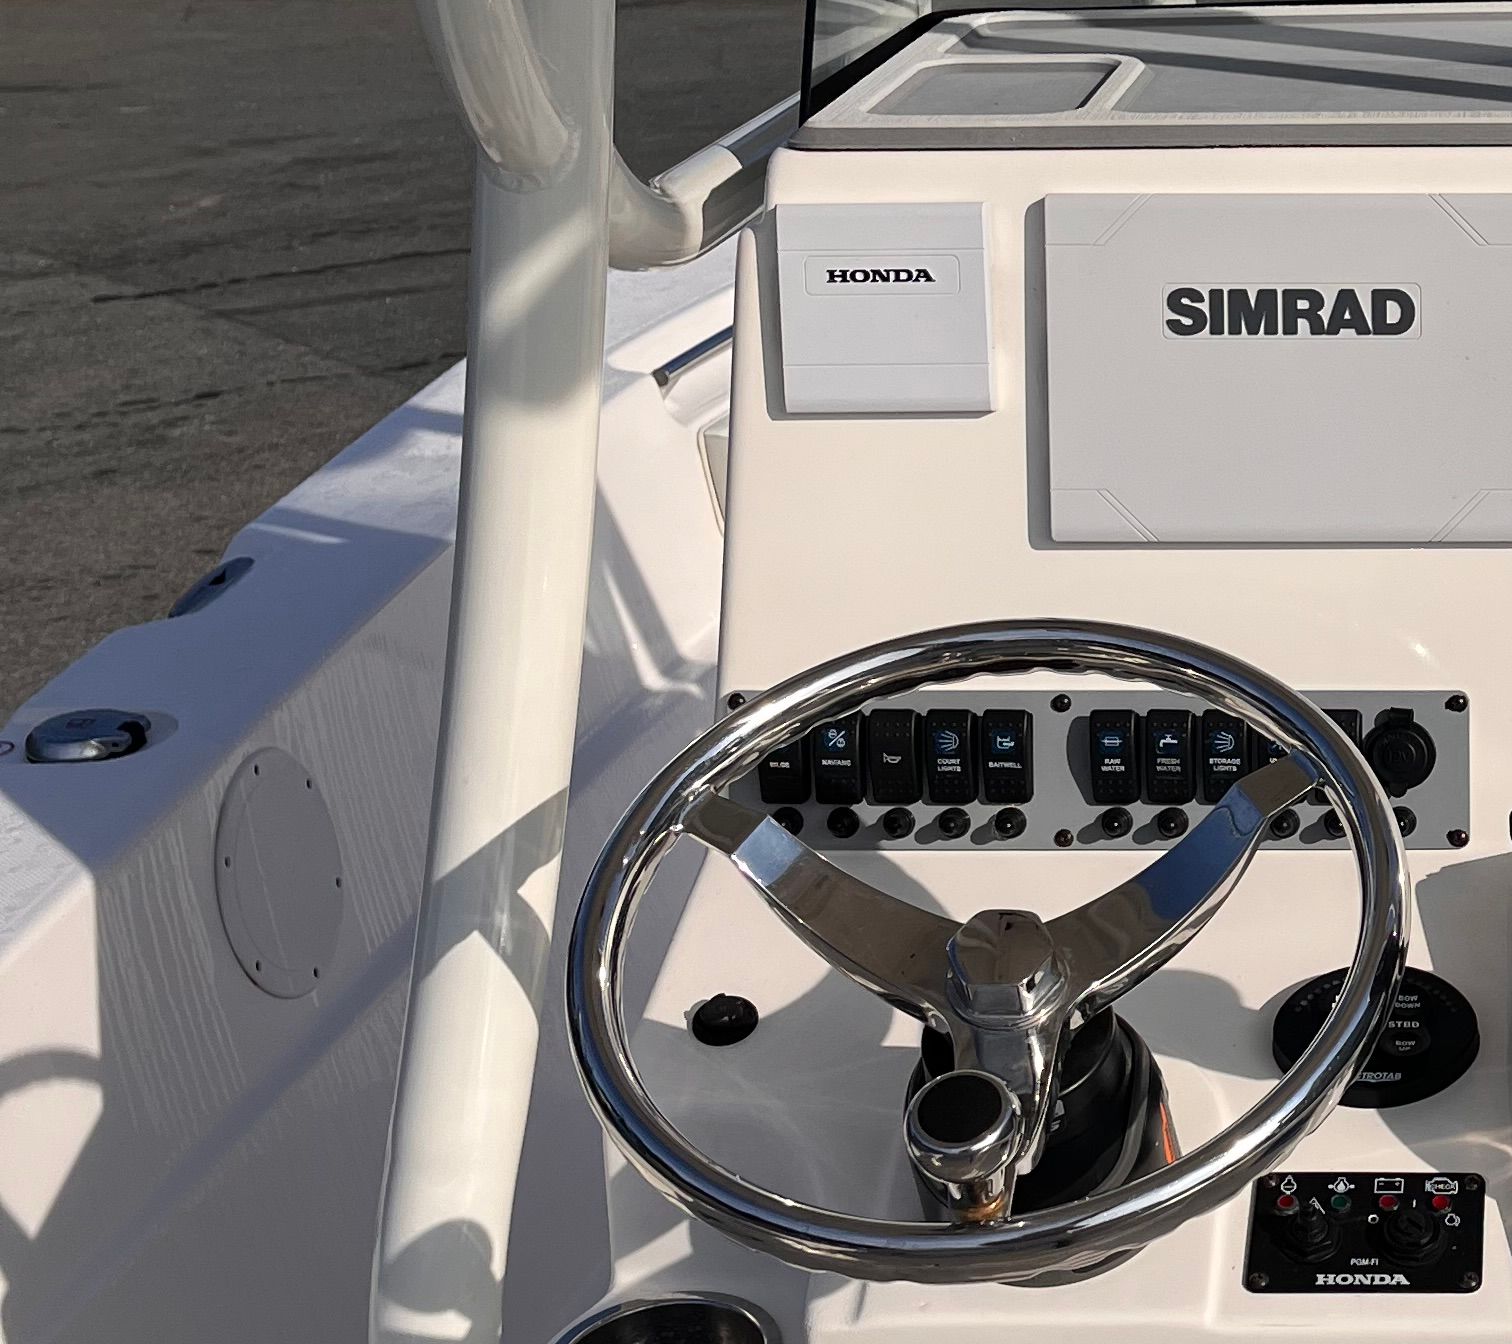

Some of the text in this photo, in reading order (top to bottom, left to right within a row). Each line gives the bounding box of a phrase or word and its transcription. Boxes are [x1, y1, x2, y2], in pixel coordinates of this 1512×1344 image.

[825, 269, 936, 284] HONDA
[1165, 287, 1416, 336] SIMRAD
[988, 761, 1023, 769] BAITWELL
[1350, 1258, 1379, 1266] PGM-FI
[1315, 1273, 1411, 1286] HONDA
